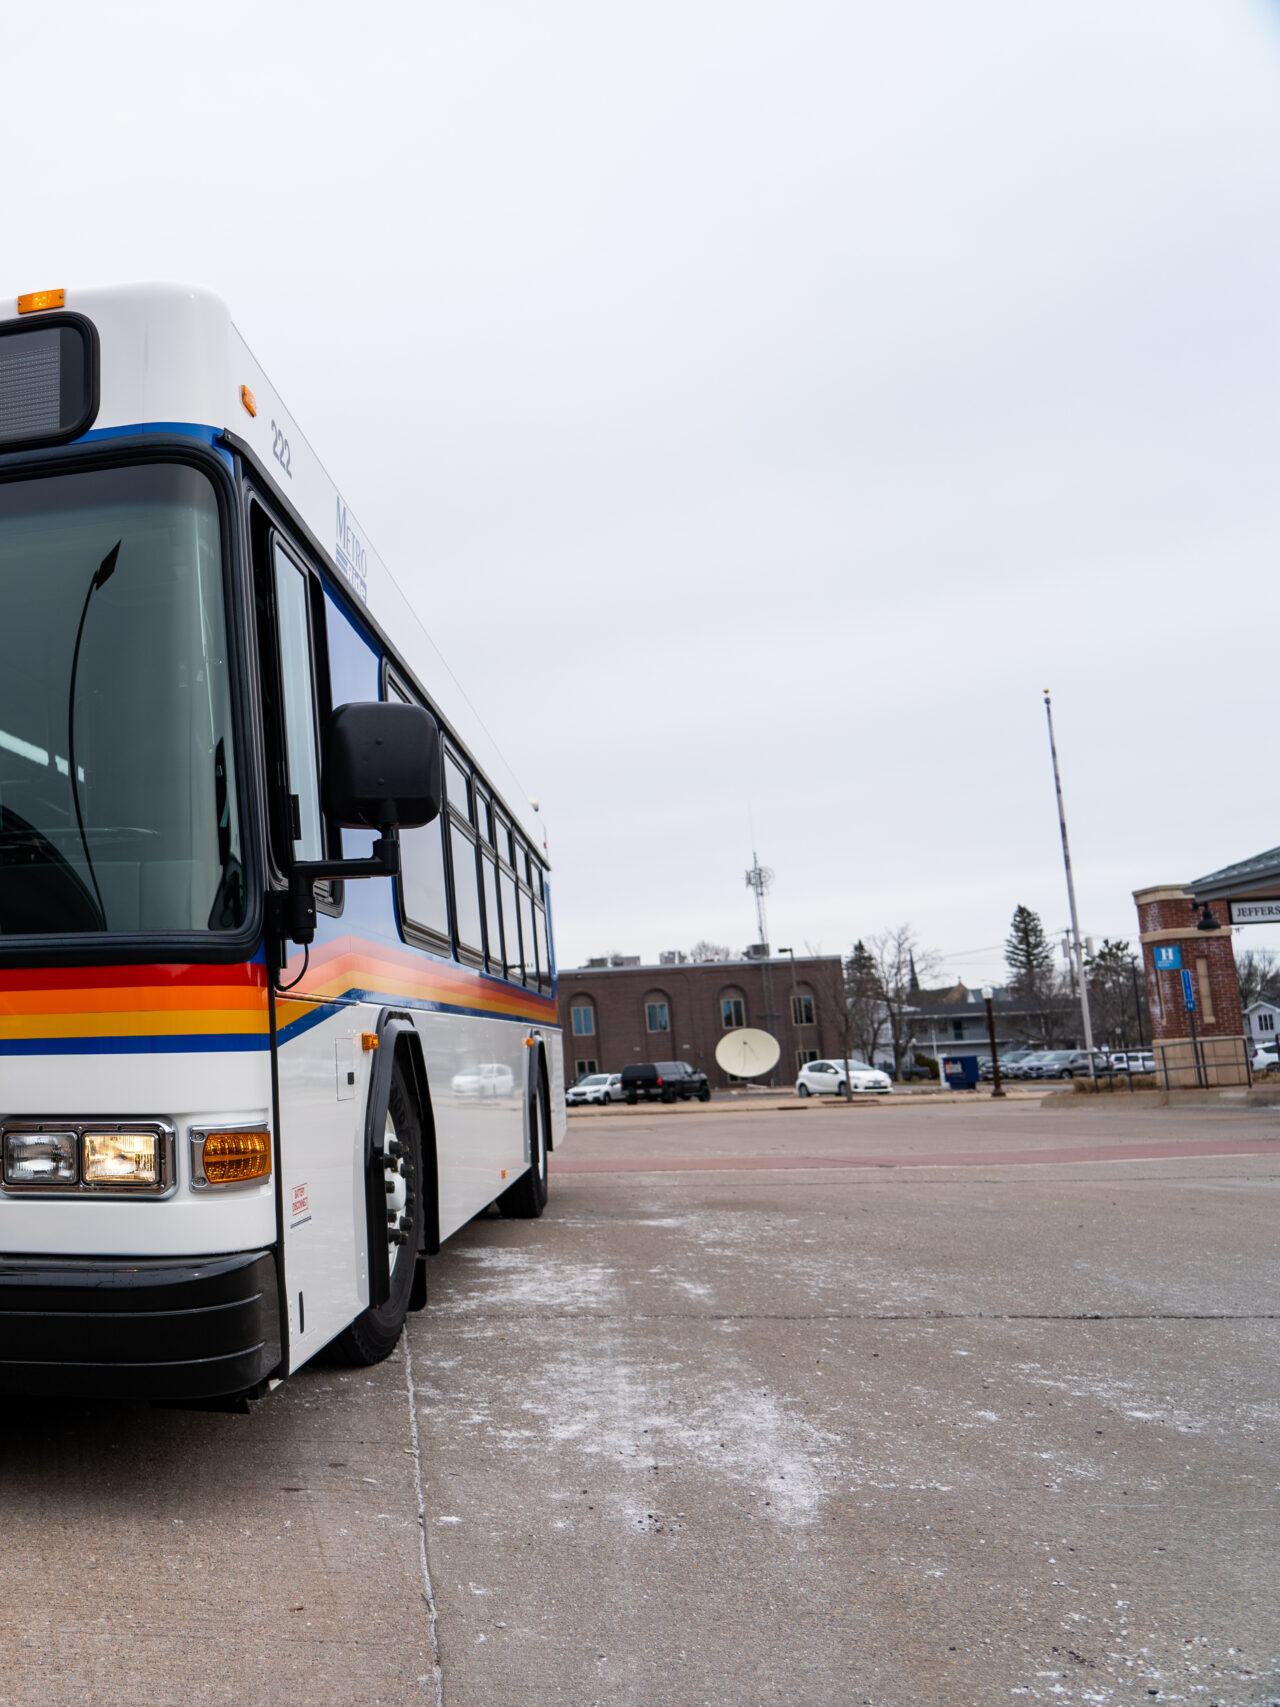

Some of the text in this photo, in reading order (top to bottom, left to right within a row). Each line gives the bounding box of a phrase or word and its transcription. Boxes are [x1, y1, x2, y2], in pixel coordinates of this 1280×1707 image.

[271, 419, 292, 480] 222
[335, 495, 367, 578] METRO
[1161, 948, 1174, 960] H
